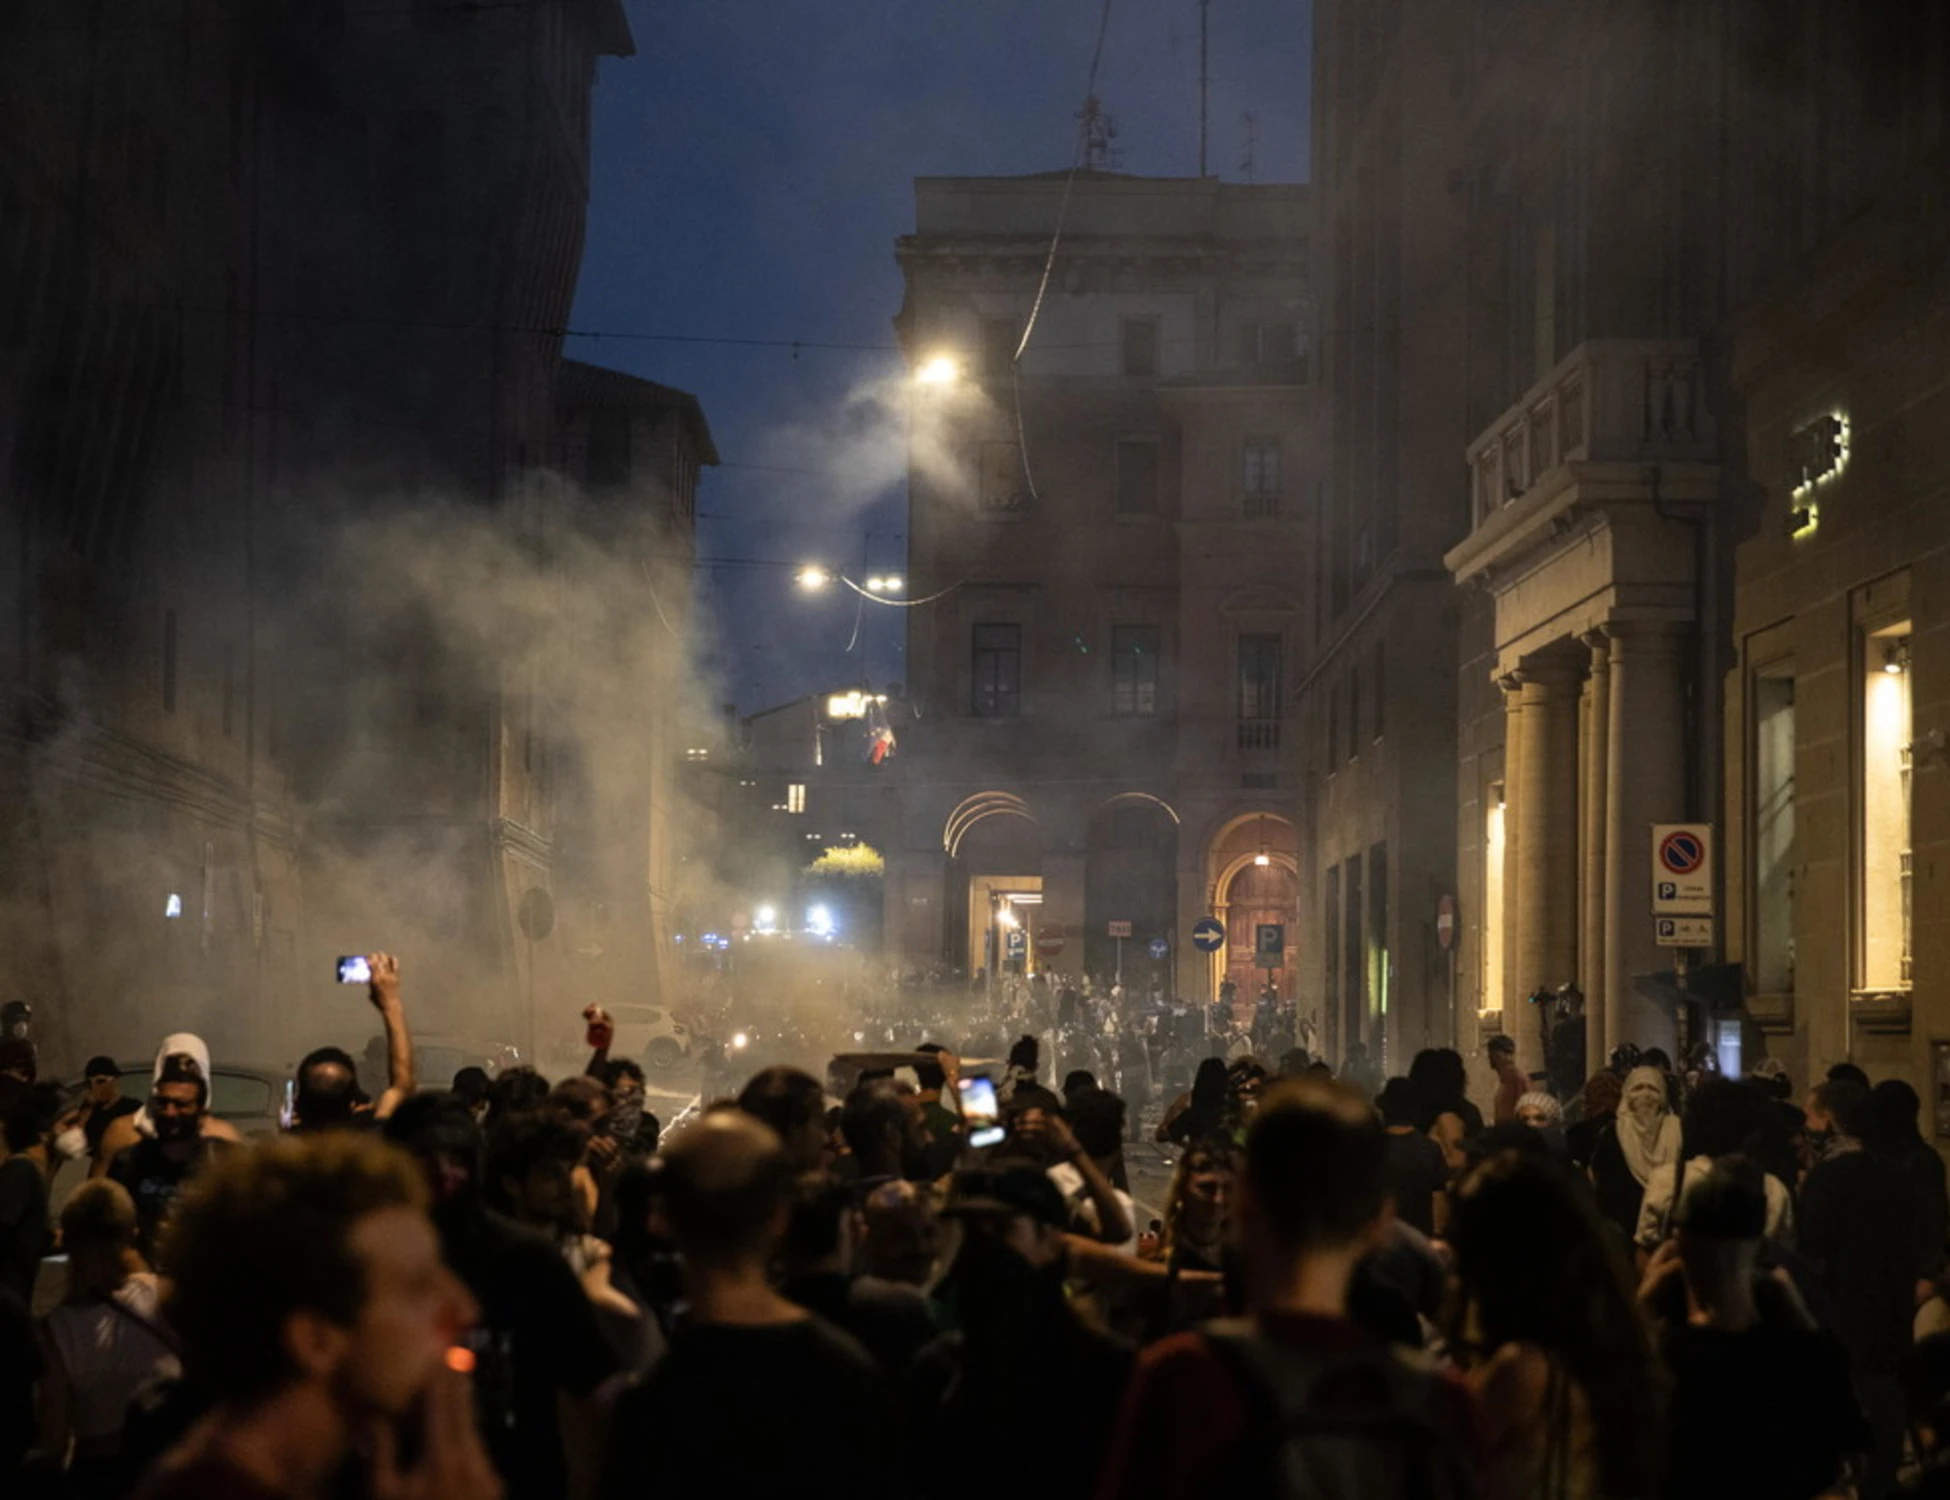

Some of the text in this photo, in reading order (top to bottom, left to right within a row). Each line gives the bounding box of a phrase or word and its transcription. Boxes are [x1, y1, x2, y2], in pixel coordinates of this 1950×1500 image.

[1662, 884, 1674, 899] P
[1259, 926, 1277, 945] P
[1662, 922, 1672, 935] P
[1010, 933, 1021, 947] P
